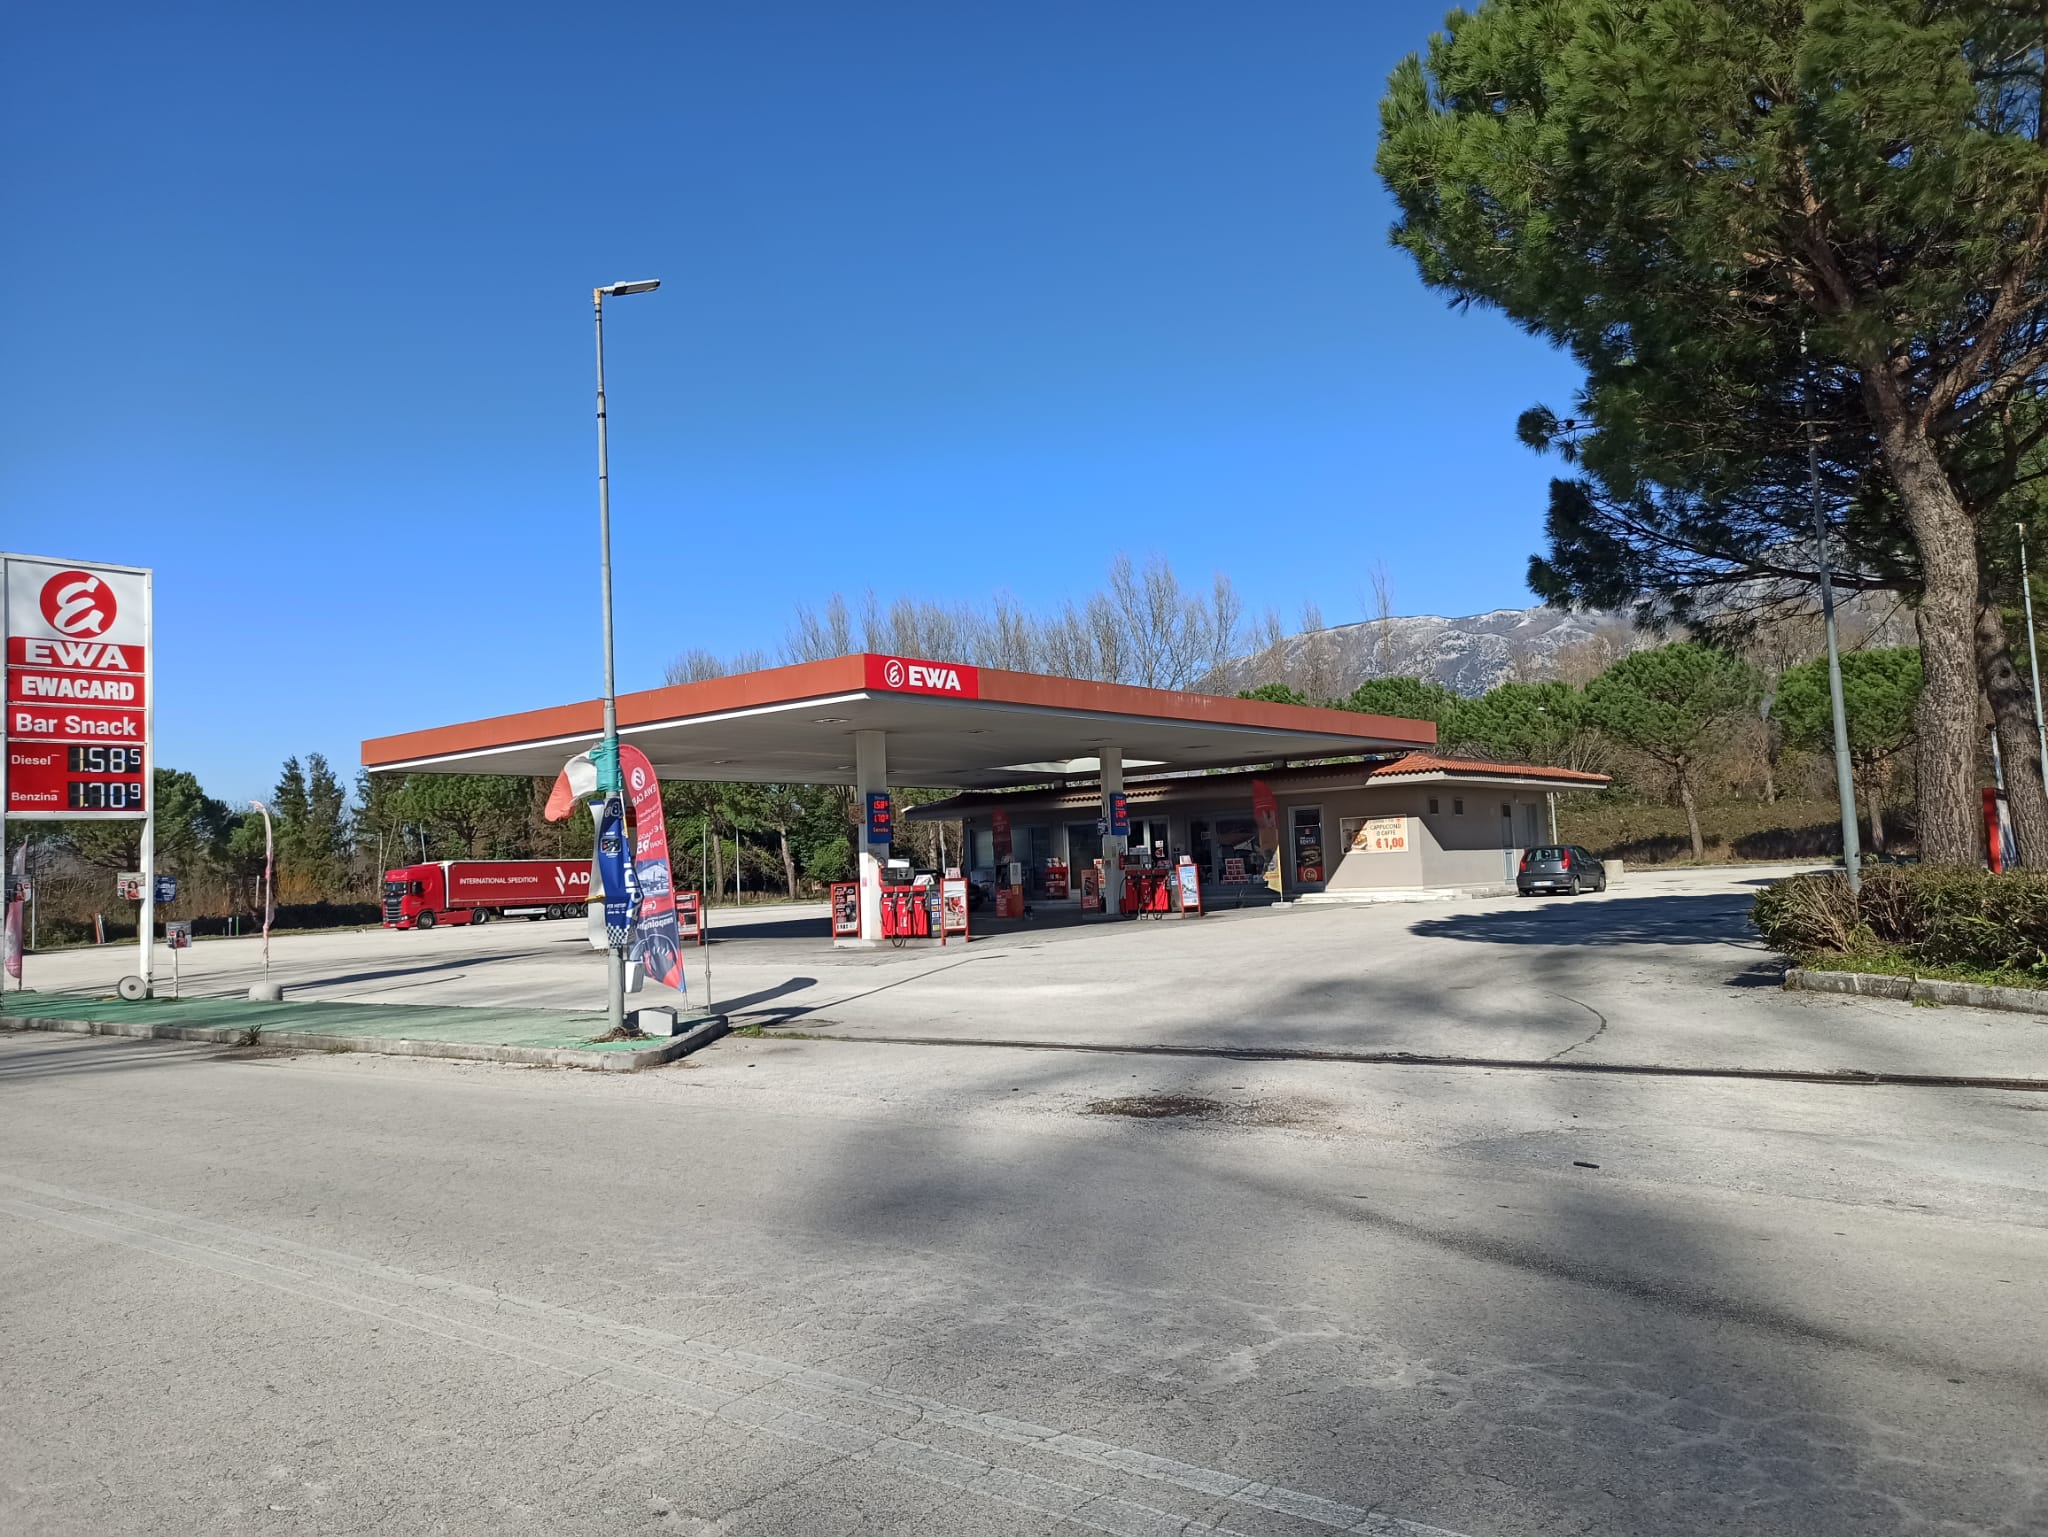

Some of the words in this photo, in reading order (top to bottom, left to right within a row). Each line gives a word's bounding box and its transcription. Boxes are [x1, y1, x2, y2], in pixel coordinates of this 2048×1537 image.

[25, 638, 129, 670] EWA
[908, 665, 961, 691] EWA
[22, 675, 135, 700] EWACARD
[15, 713, 58, 733] Bar
[64, 715, 137, 736] Snack
[11, 754, 51, 765] Diesel
[11, 791, 58, 801] Benzina
[1384, 837, 1404, 850] 1,00
[460, 877, 506, 885] INTERNATIONAL
[508, 876, 538, 884] SPEDITION
